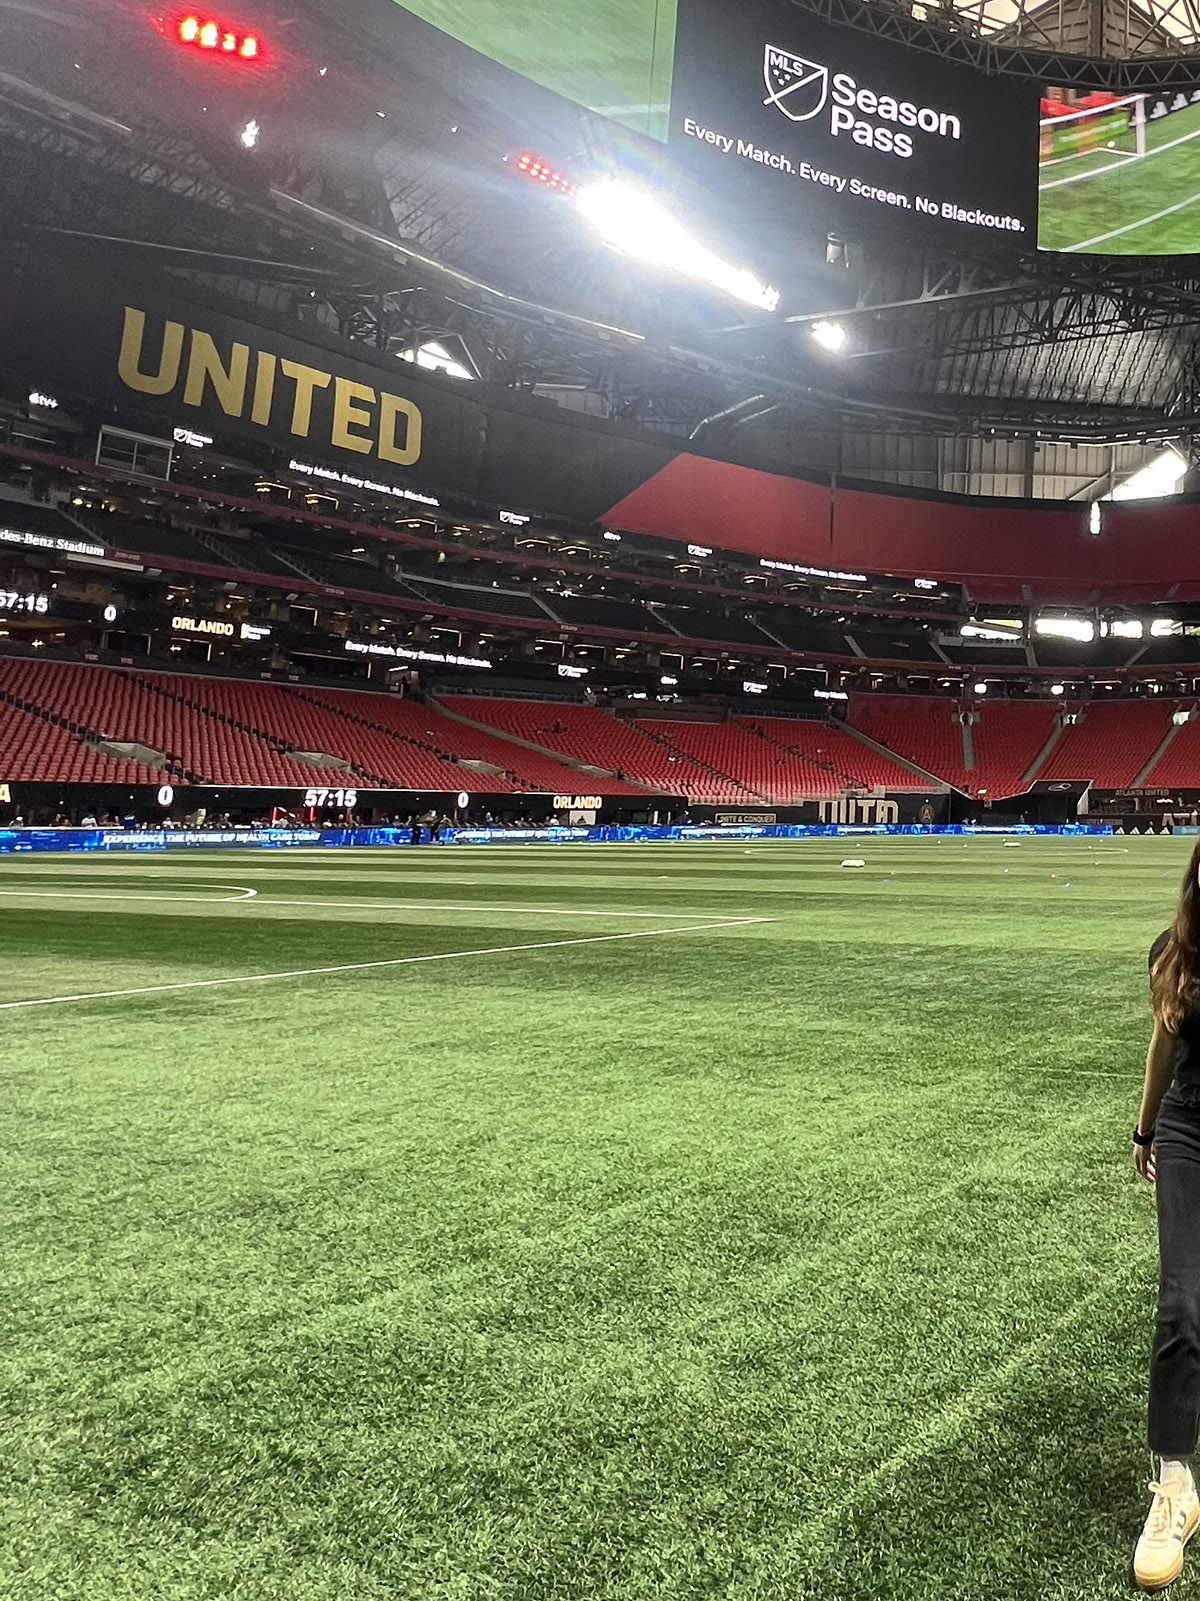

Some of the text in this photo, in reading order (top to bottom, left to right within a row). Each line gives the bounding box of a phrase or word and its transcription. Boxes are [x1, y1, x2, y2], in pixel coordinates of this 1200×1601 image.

[770, 52, 803, 77] MLS
[832, 74, 961, 140] Season
[830, 105, 913, 158] Pass
[684, 118, 1025, 232] Every Match. Every Screen. No Blackouts.
[117, 306, 423, 466] UNITED
[56, 538, 104, 556] Stadium
[104, 604, 117, 621] 0
[172, 616, 234, 636] ORLANDO
[158, 786, 174, 806] 0
[305, 788, 357, 806] 57:15
[458, 791, 469, 808] 0
[553, 795, 602, 809] ORLANDO
